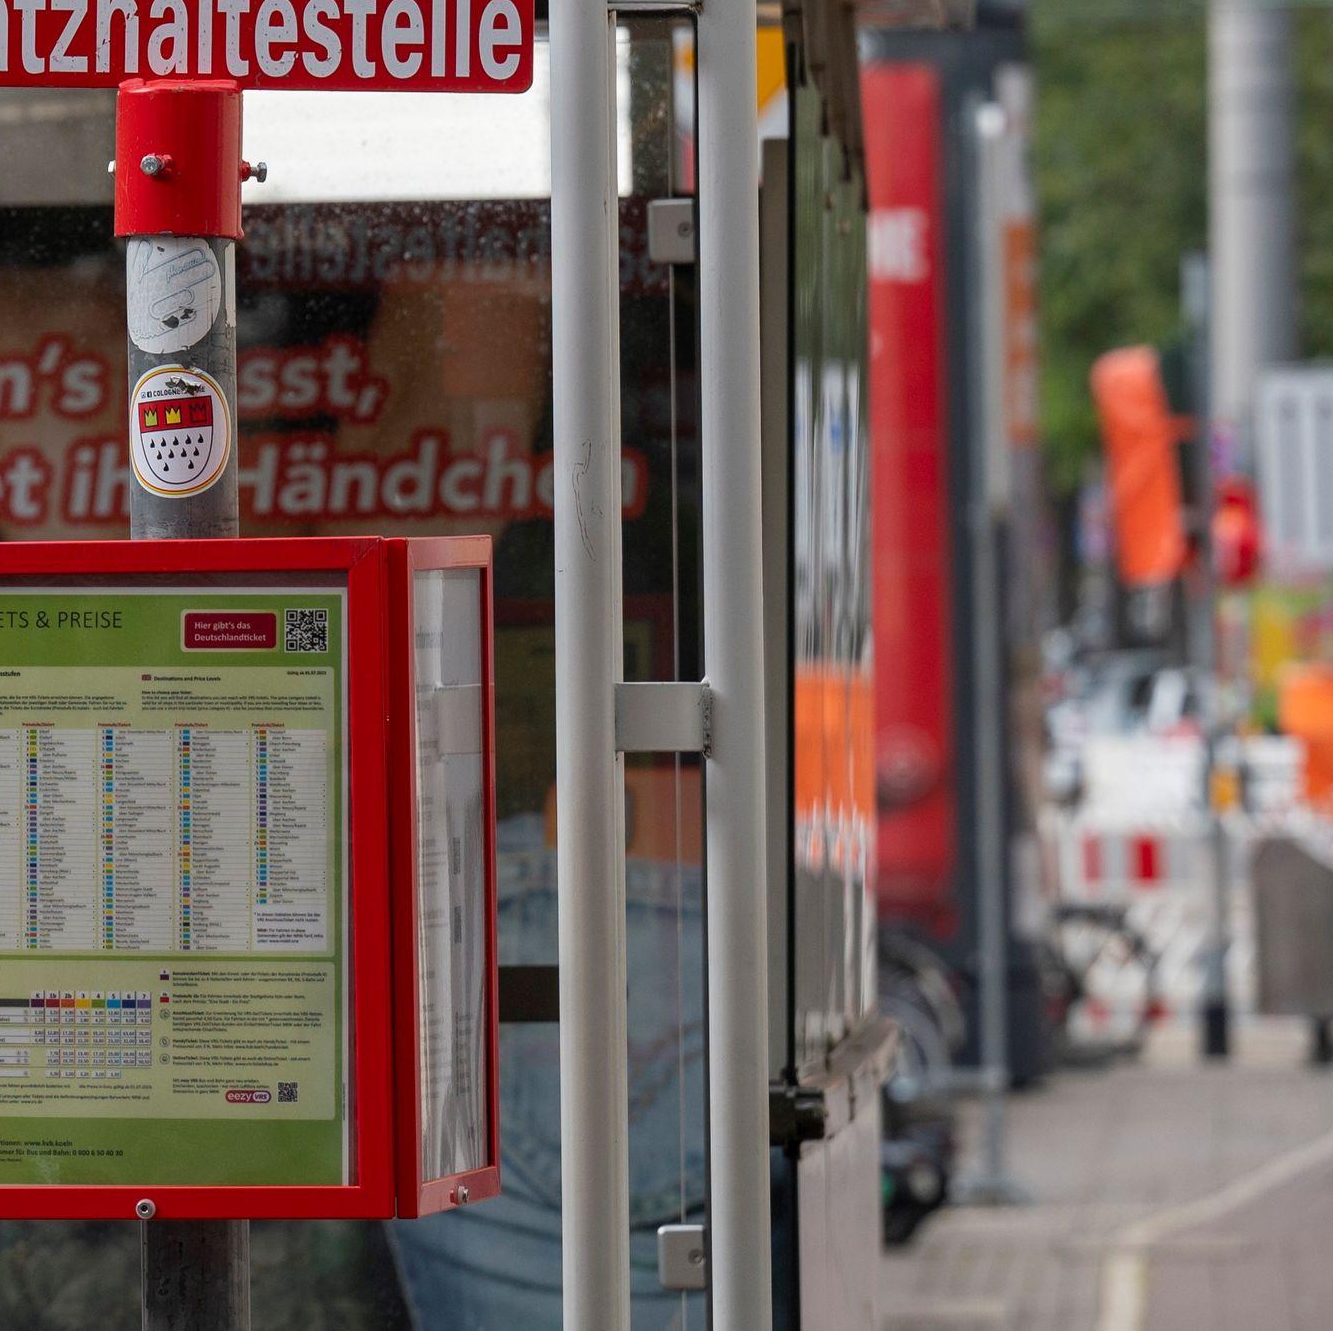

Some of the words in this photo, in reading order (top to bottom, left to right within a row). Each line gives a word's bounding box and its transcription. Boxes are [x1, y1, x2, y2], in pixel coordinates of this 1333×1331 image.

[238, 339, 386, 416] sst,
[238, 433, 644, 513] Händch
[35, 610, 51, 629] &
[58, 610, 123, 629] PREISE
[194, 621, 211, 630] Hier
[212, 621, 235, 632] gibt's
[236, 621, 251, 630] das
[194, 633, 266, 643] Deutschlandticket
[227, 1092, 252, 1103] eezy
